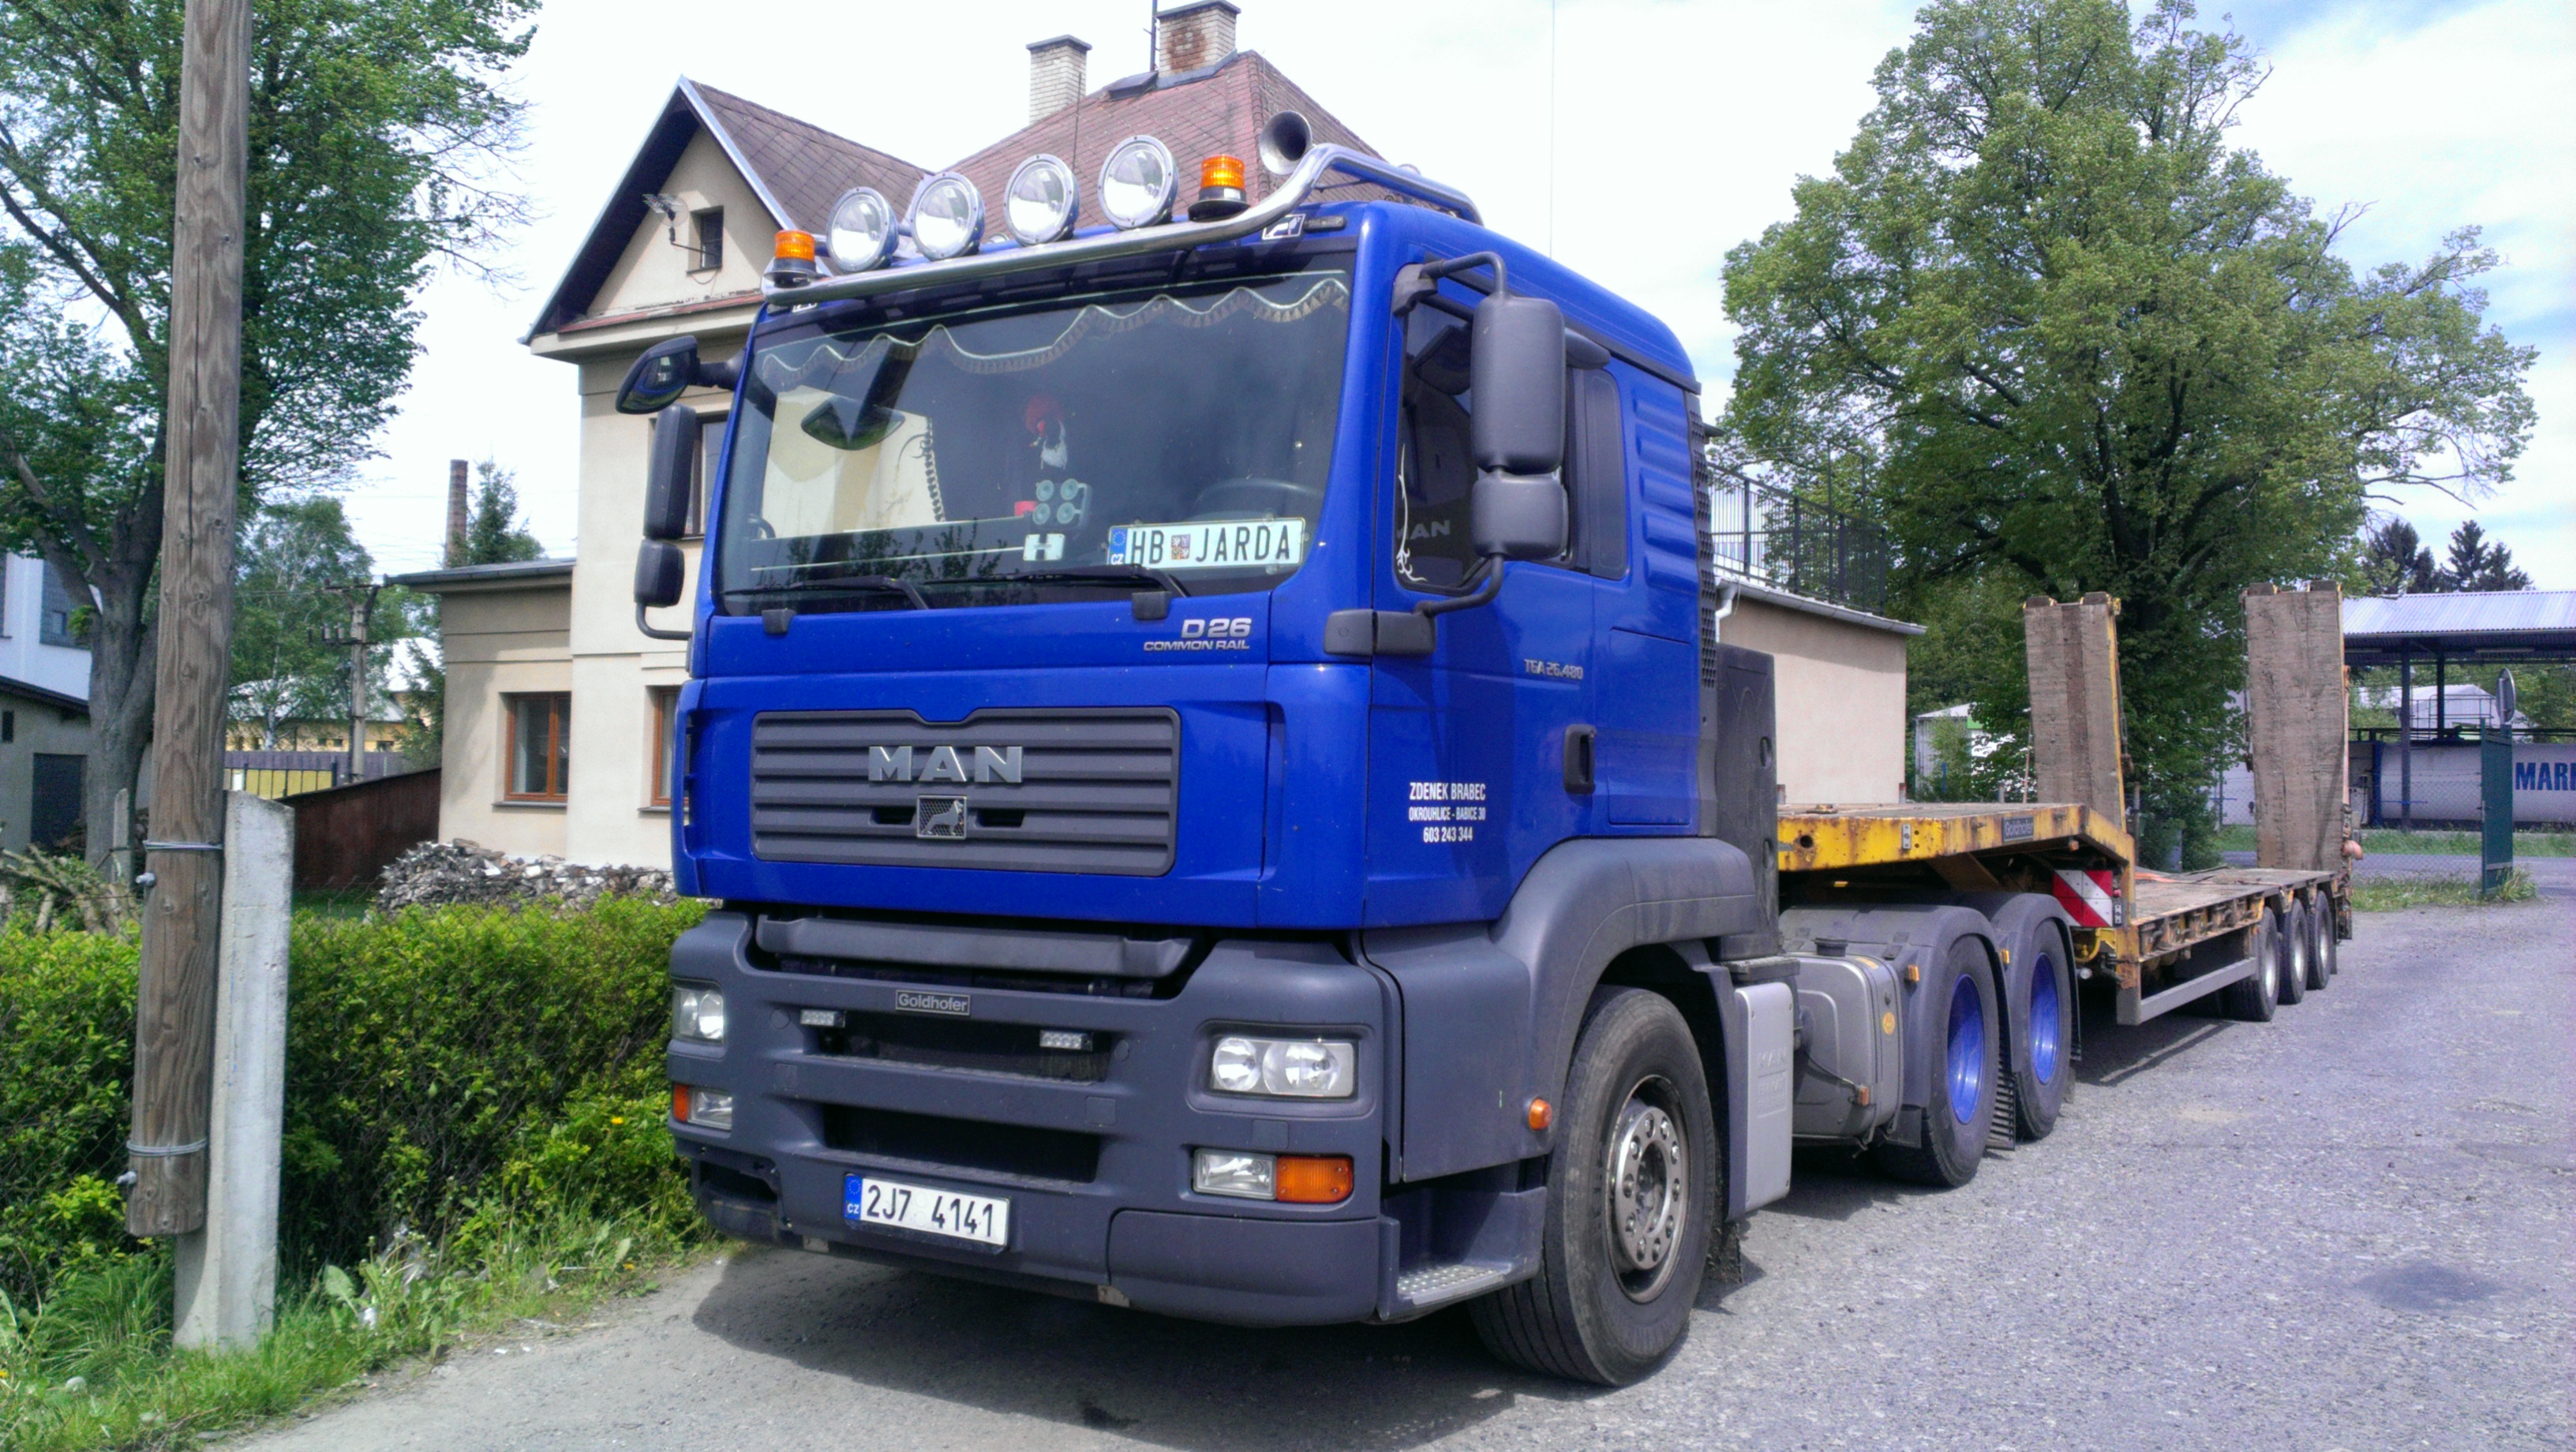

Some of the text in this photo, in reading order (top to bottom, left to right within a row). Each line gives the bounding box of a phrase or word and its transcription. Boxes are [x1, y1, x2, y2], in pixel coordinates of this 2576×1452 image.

[1110, 525, 1290, 565] CZ HB JARDA
[1144, 639, 1250, 651] COMMON RAIL
[1524, 658, 1544, 675] TGA
[869, 746, 1023, 783] MAN
[1410, 782, 1486, 801] ZDENEK BRABEC
[1408, 806, 1451, 821] OKROUHLICE
[1423, 826, 1473, 843] 603 243 344
[898, 993, 968, 1012] Goldhofer
[847, 1184, 993, 1237] CZ 2J7 4141
